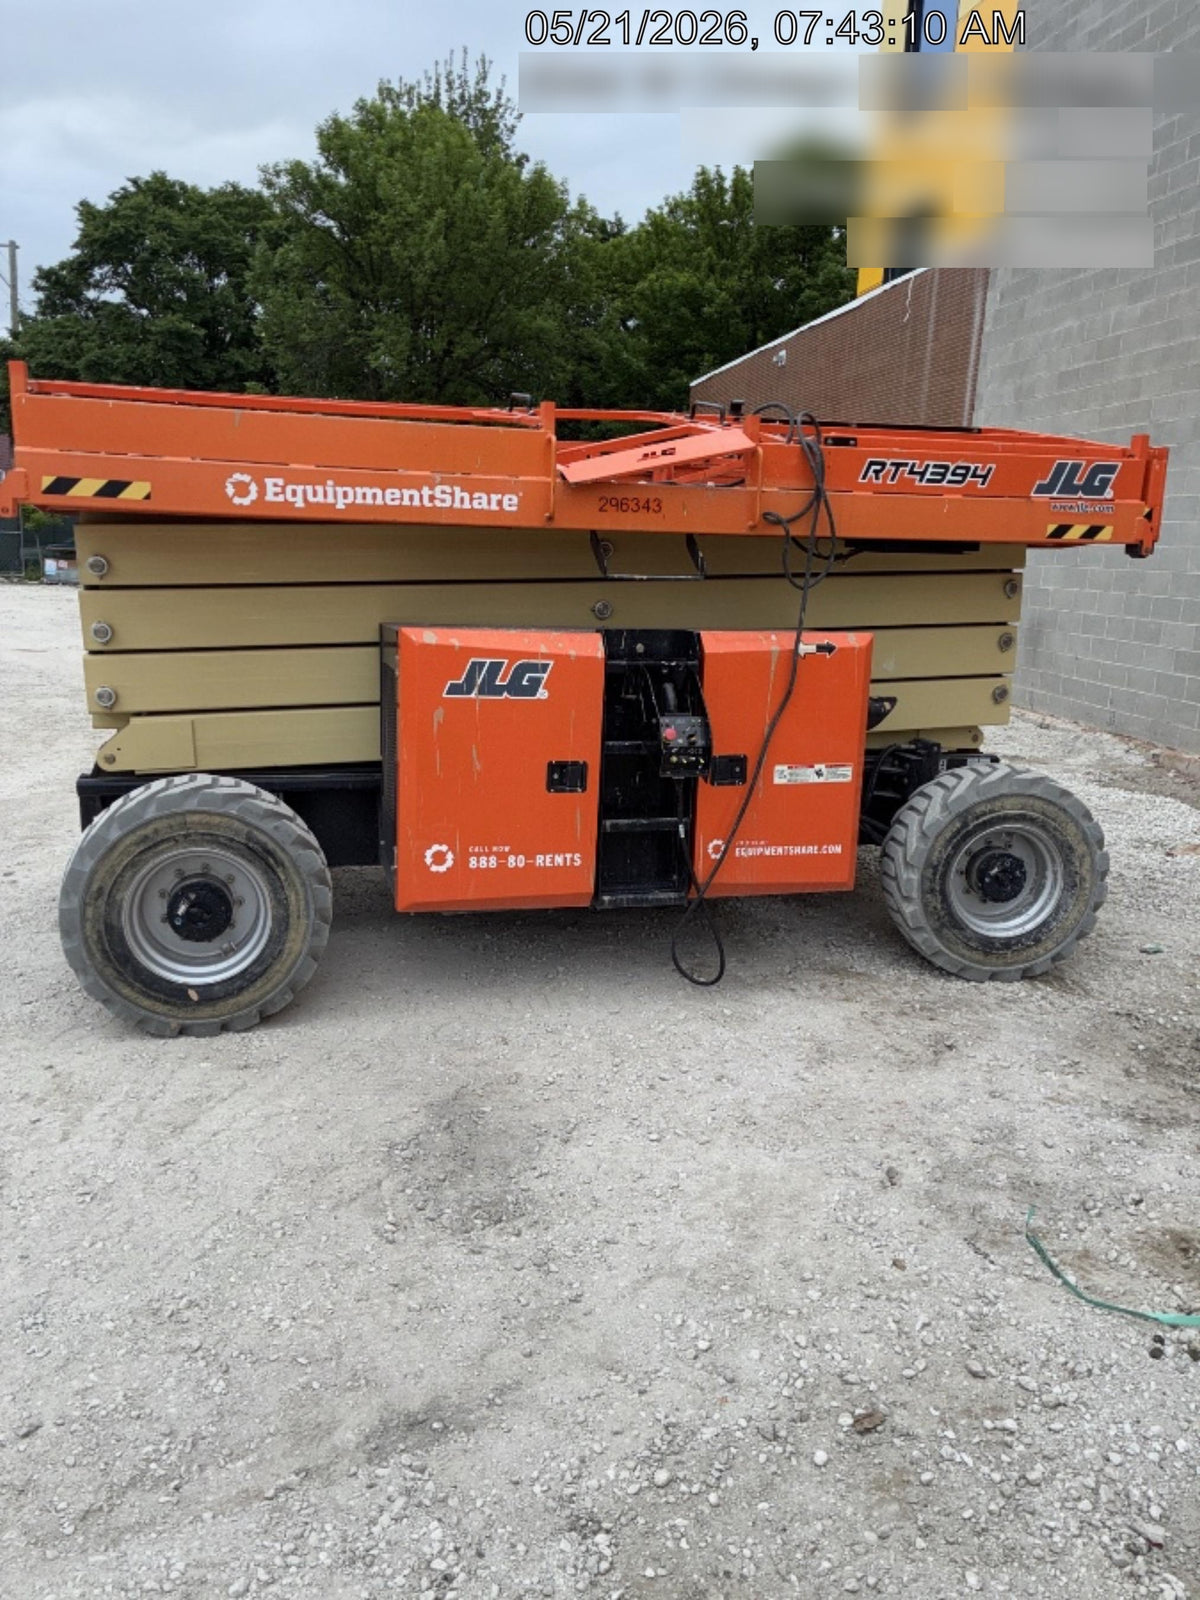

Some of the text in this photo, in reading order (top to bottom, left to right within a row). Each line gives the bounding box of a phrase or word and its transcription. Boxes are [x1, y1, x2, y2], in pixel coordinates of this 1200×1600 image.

[858, 458, 996, 488] RT4394
[1030, 460, 1122, 499] JLG
[264, 477, 519, 511] EquipmentShare
[598, 496, 663, 514] 296343
[442, 658, 554, 699] JLG
[468, 845, 489, 853] CALL
[468, 853, 582, 869] 888-80-RENTS
